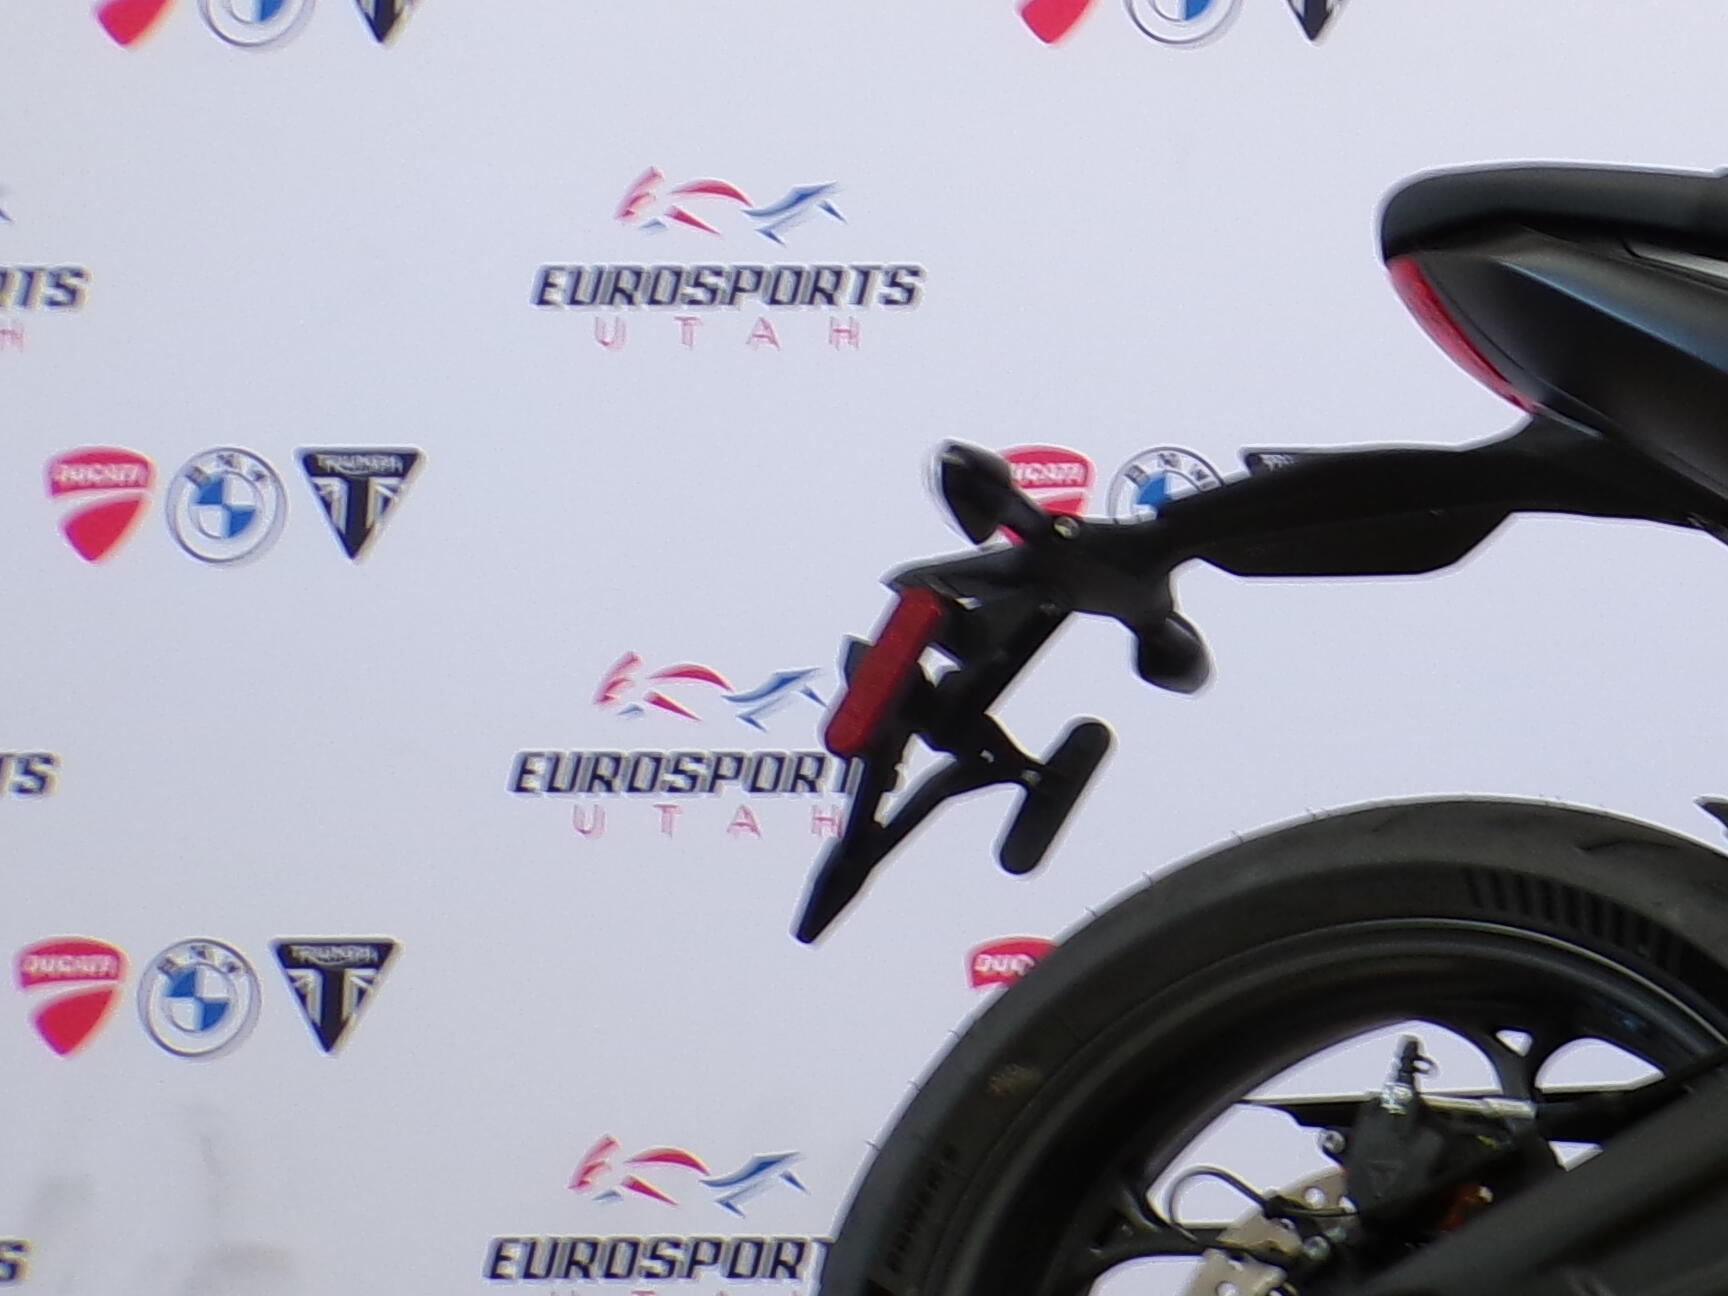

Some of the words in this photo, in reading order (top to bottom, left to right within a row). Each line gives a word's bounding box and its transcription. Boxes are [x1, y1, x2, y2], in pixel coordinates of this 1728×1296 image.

[533, 263, 924, 308] EUROSPORTS
[594, 315, 860, 351] UTAH
[512, 751, 906, 797] EUROSPORT
